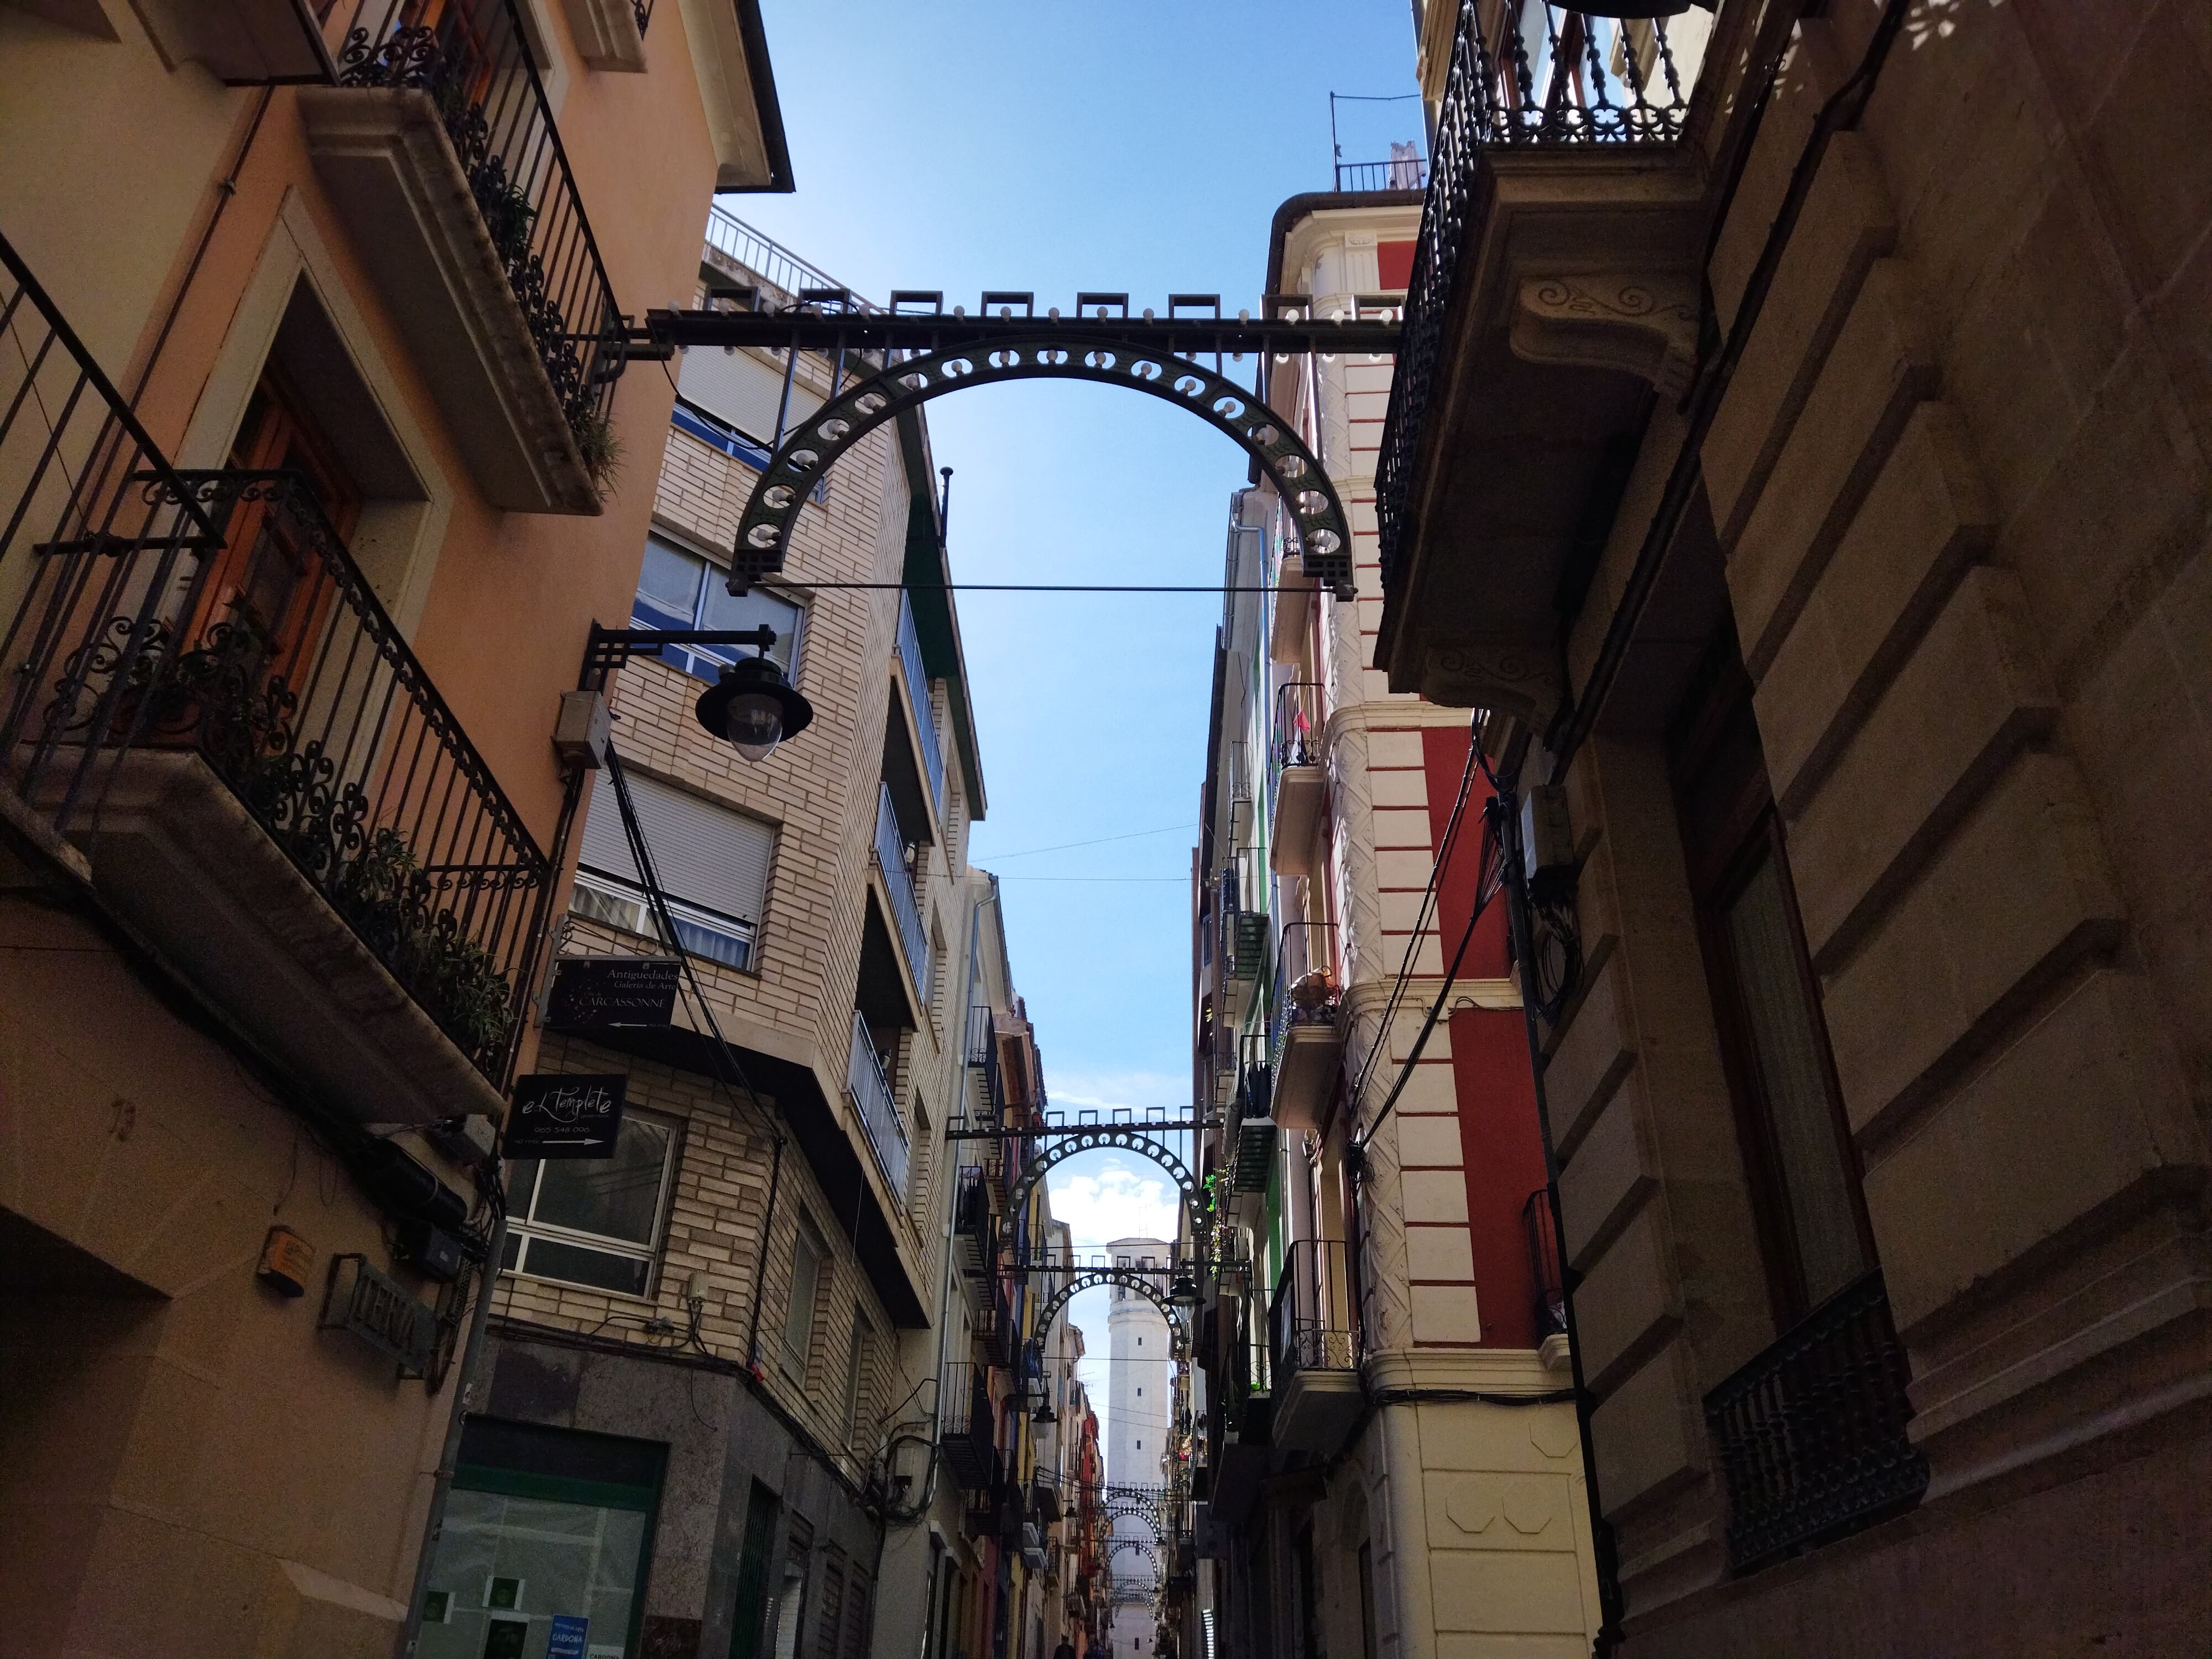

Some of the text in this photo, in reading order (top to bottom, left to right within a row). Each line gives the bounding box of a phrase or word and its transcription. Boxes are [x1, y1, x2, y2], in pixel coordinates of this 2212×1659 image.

[607, 969, 678, 980] Antiguedades
[659, 982, 676, 990] Arte
[579, 997, 668, 1008] CARCASSONNE
